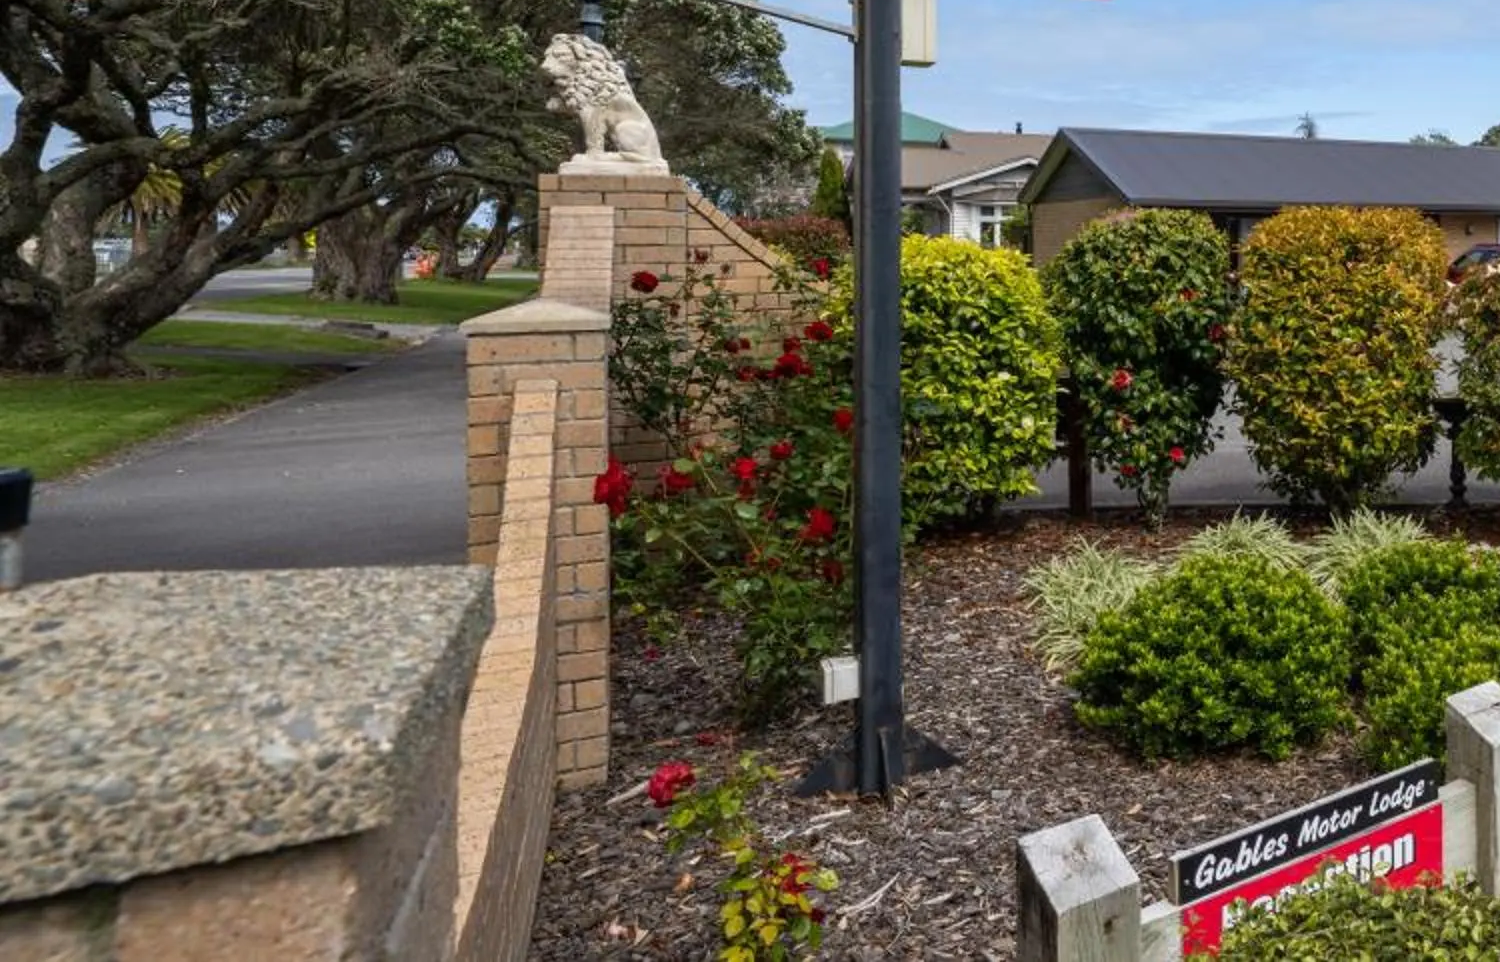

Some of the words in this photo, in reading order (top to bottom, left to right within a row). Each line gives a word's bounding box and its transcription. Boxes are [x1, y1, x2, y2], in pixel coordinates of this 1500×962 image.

[1194, 834, 1289, 889] Gables
[1296, 804, 1363, 848] Motor
[1369, 779, 1425, 817] Lodge
